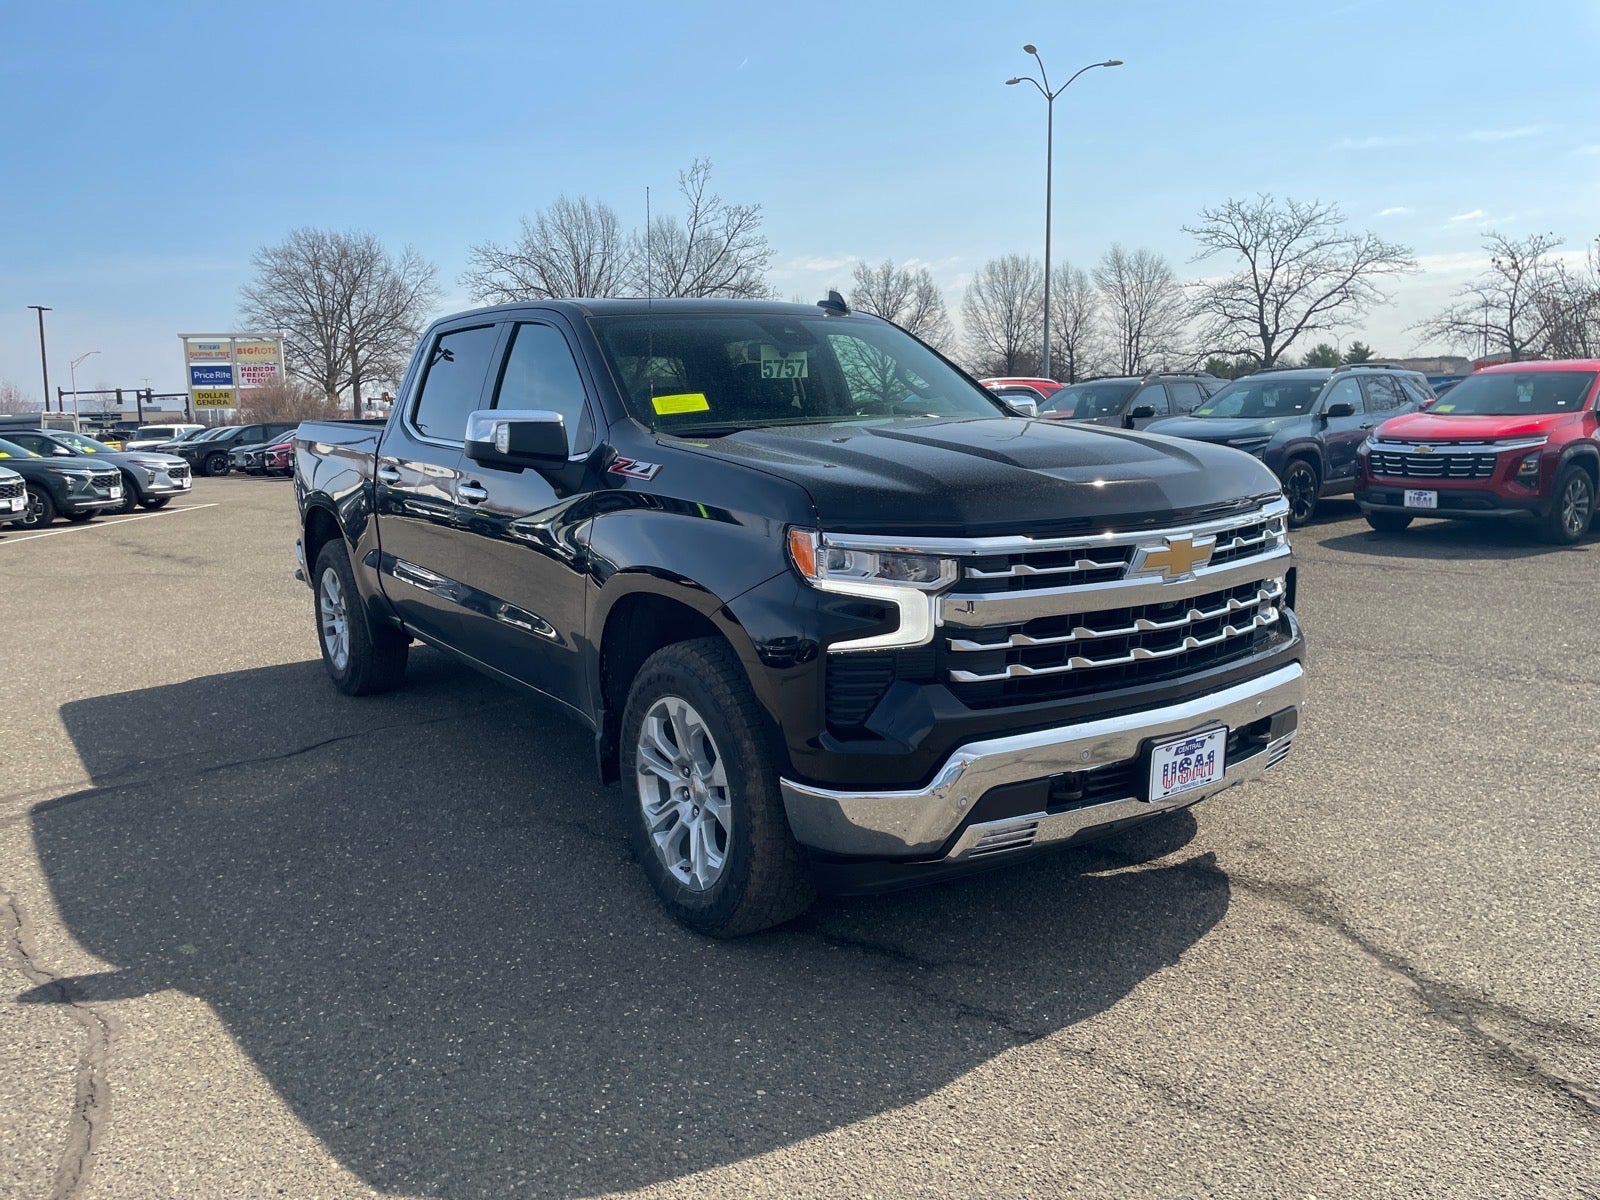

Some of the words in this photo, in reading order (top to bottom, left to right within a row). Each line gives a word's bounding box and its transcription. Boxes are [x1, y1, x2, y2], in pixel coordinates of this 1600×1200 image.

[194, 371, 215, 379] Price
[215, 371, 232, 379] Rite
[762, 359, 806, 379] 5757
[607, 456, 663, 481] Z71
[1177, 742, 1203, 754] CENTRAL
